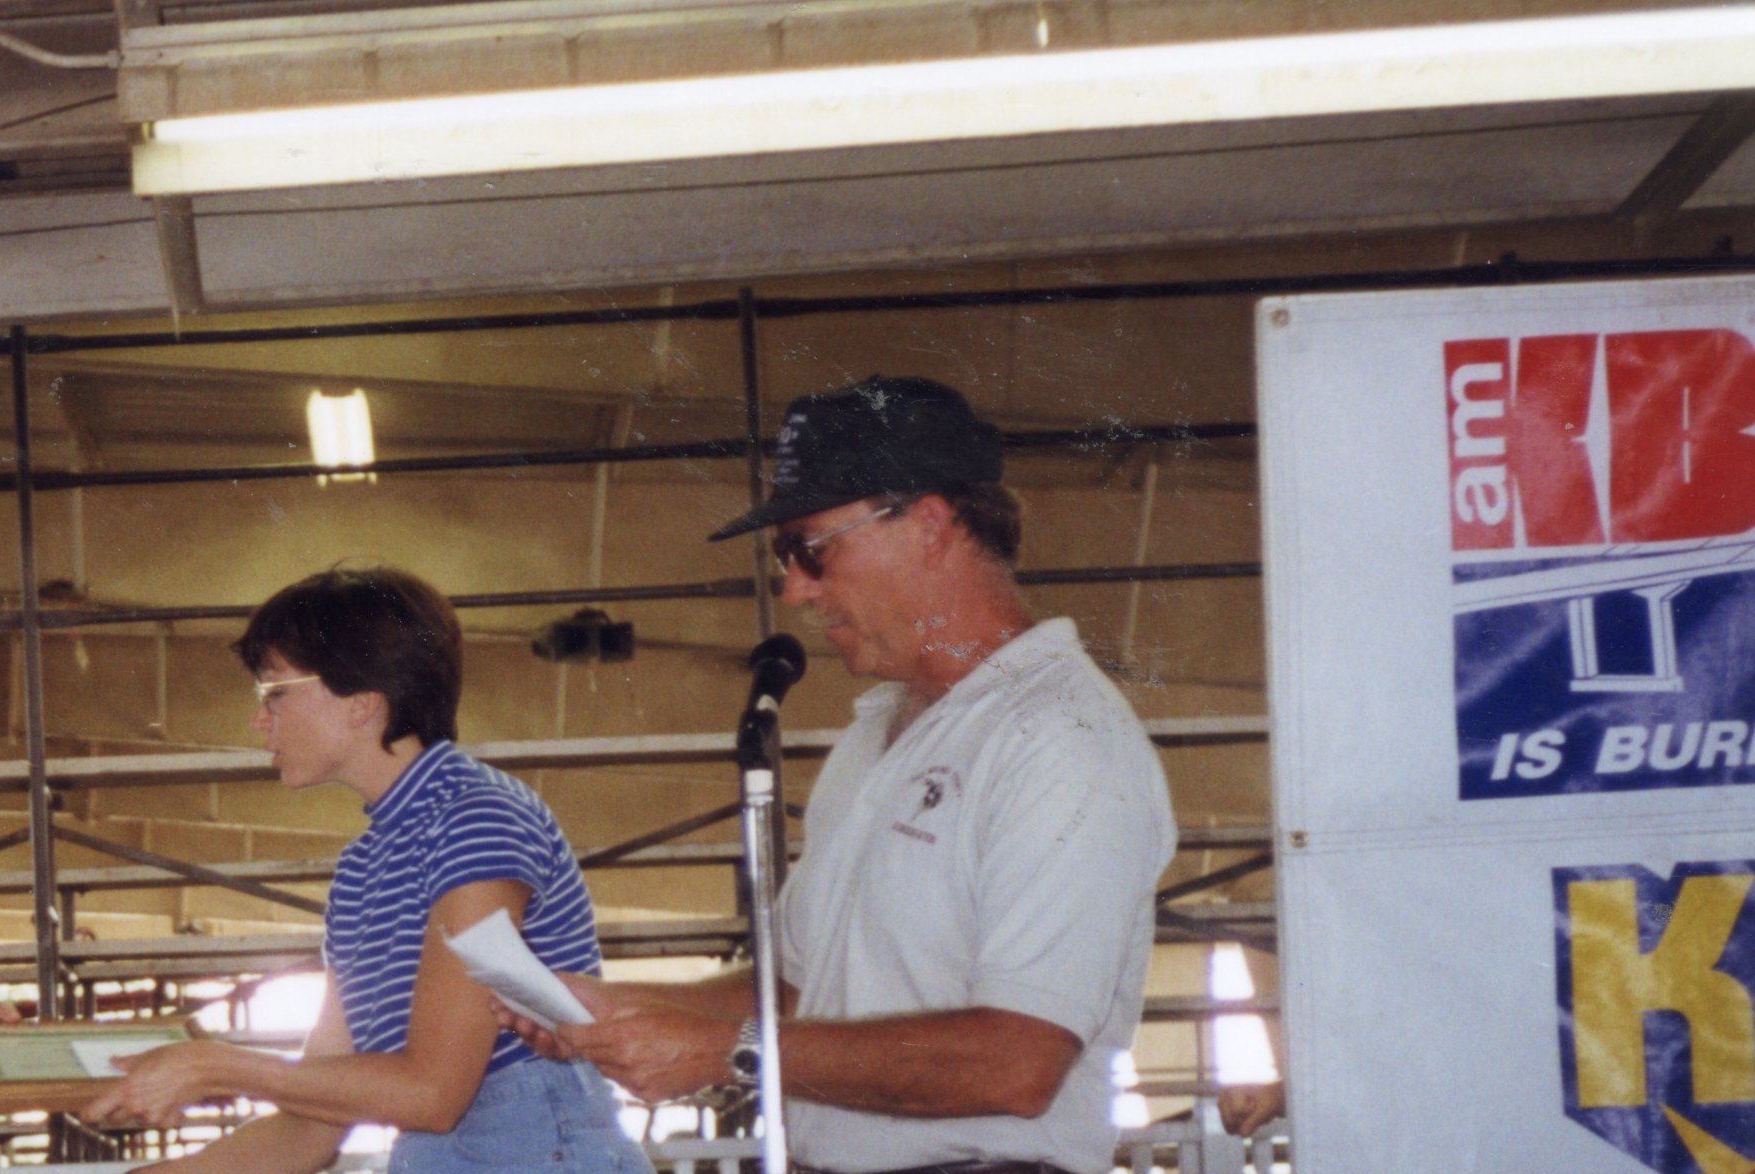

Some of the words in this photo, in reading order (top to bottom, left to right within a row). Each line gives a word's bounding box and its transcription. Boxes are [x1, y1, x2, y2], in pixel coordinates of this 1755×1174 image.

[1450, 362, 1511, 526] am
[1491, 730, 1565, 780] IS
[1596, 720, 1755, 773] BUR
